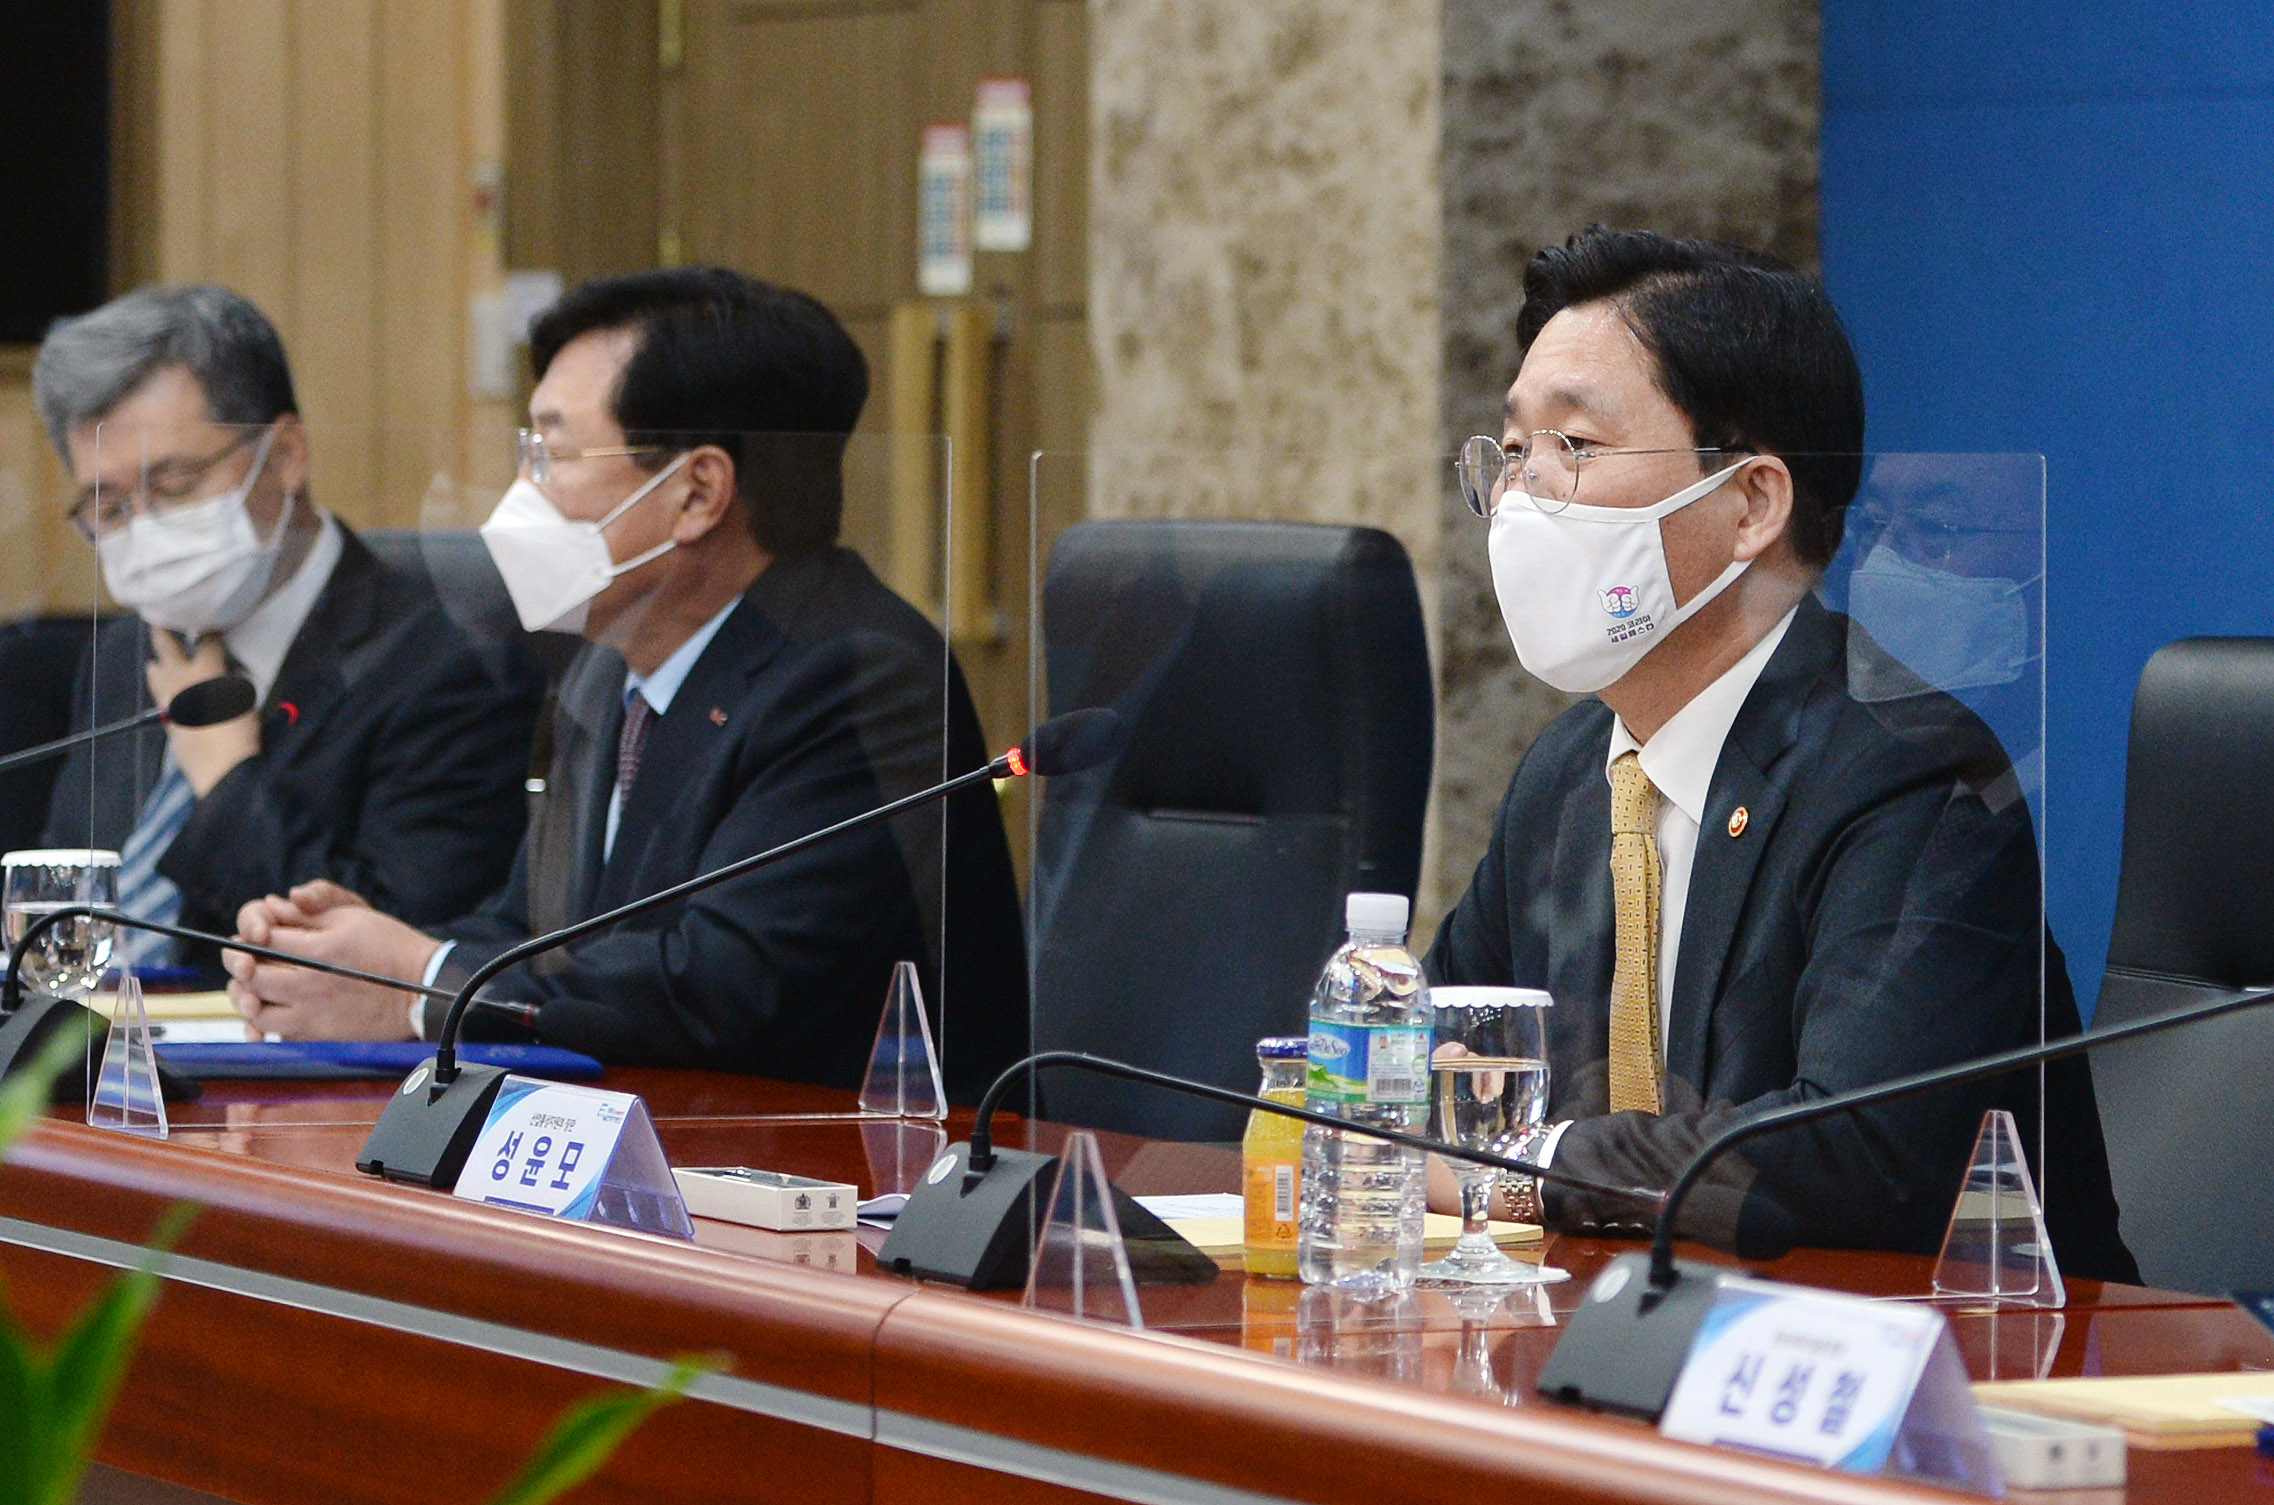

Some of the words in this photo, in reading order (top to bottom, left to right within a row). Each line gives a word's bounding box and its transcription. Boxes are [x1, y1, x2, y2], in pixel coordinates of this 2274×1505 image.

[1607, 625, 1626, 636] 2020
[1628, 615, 1651, 629] 코리아
[490, 1130, 585, 1191] 성윤모
